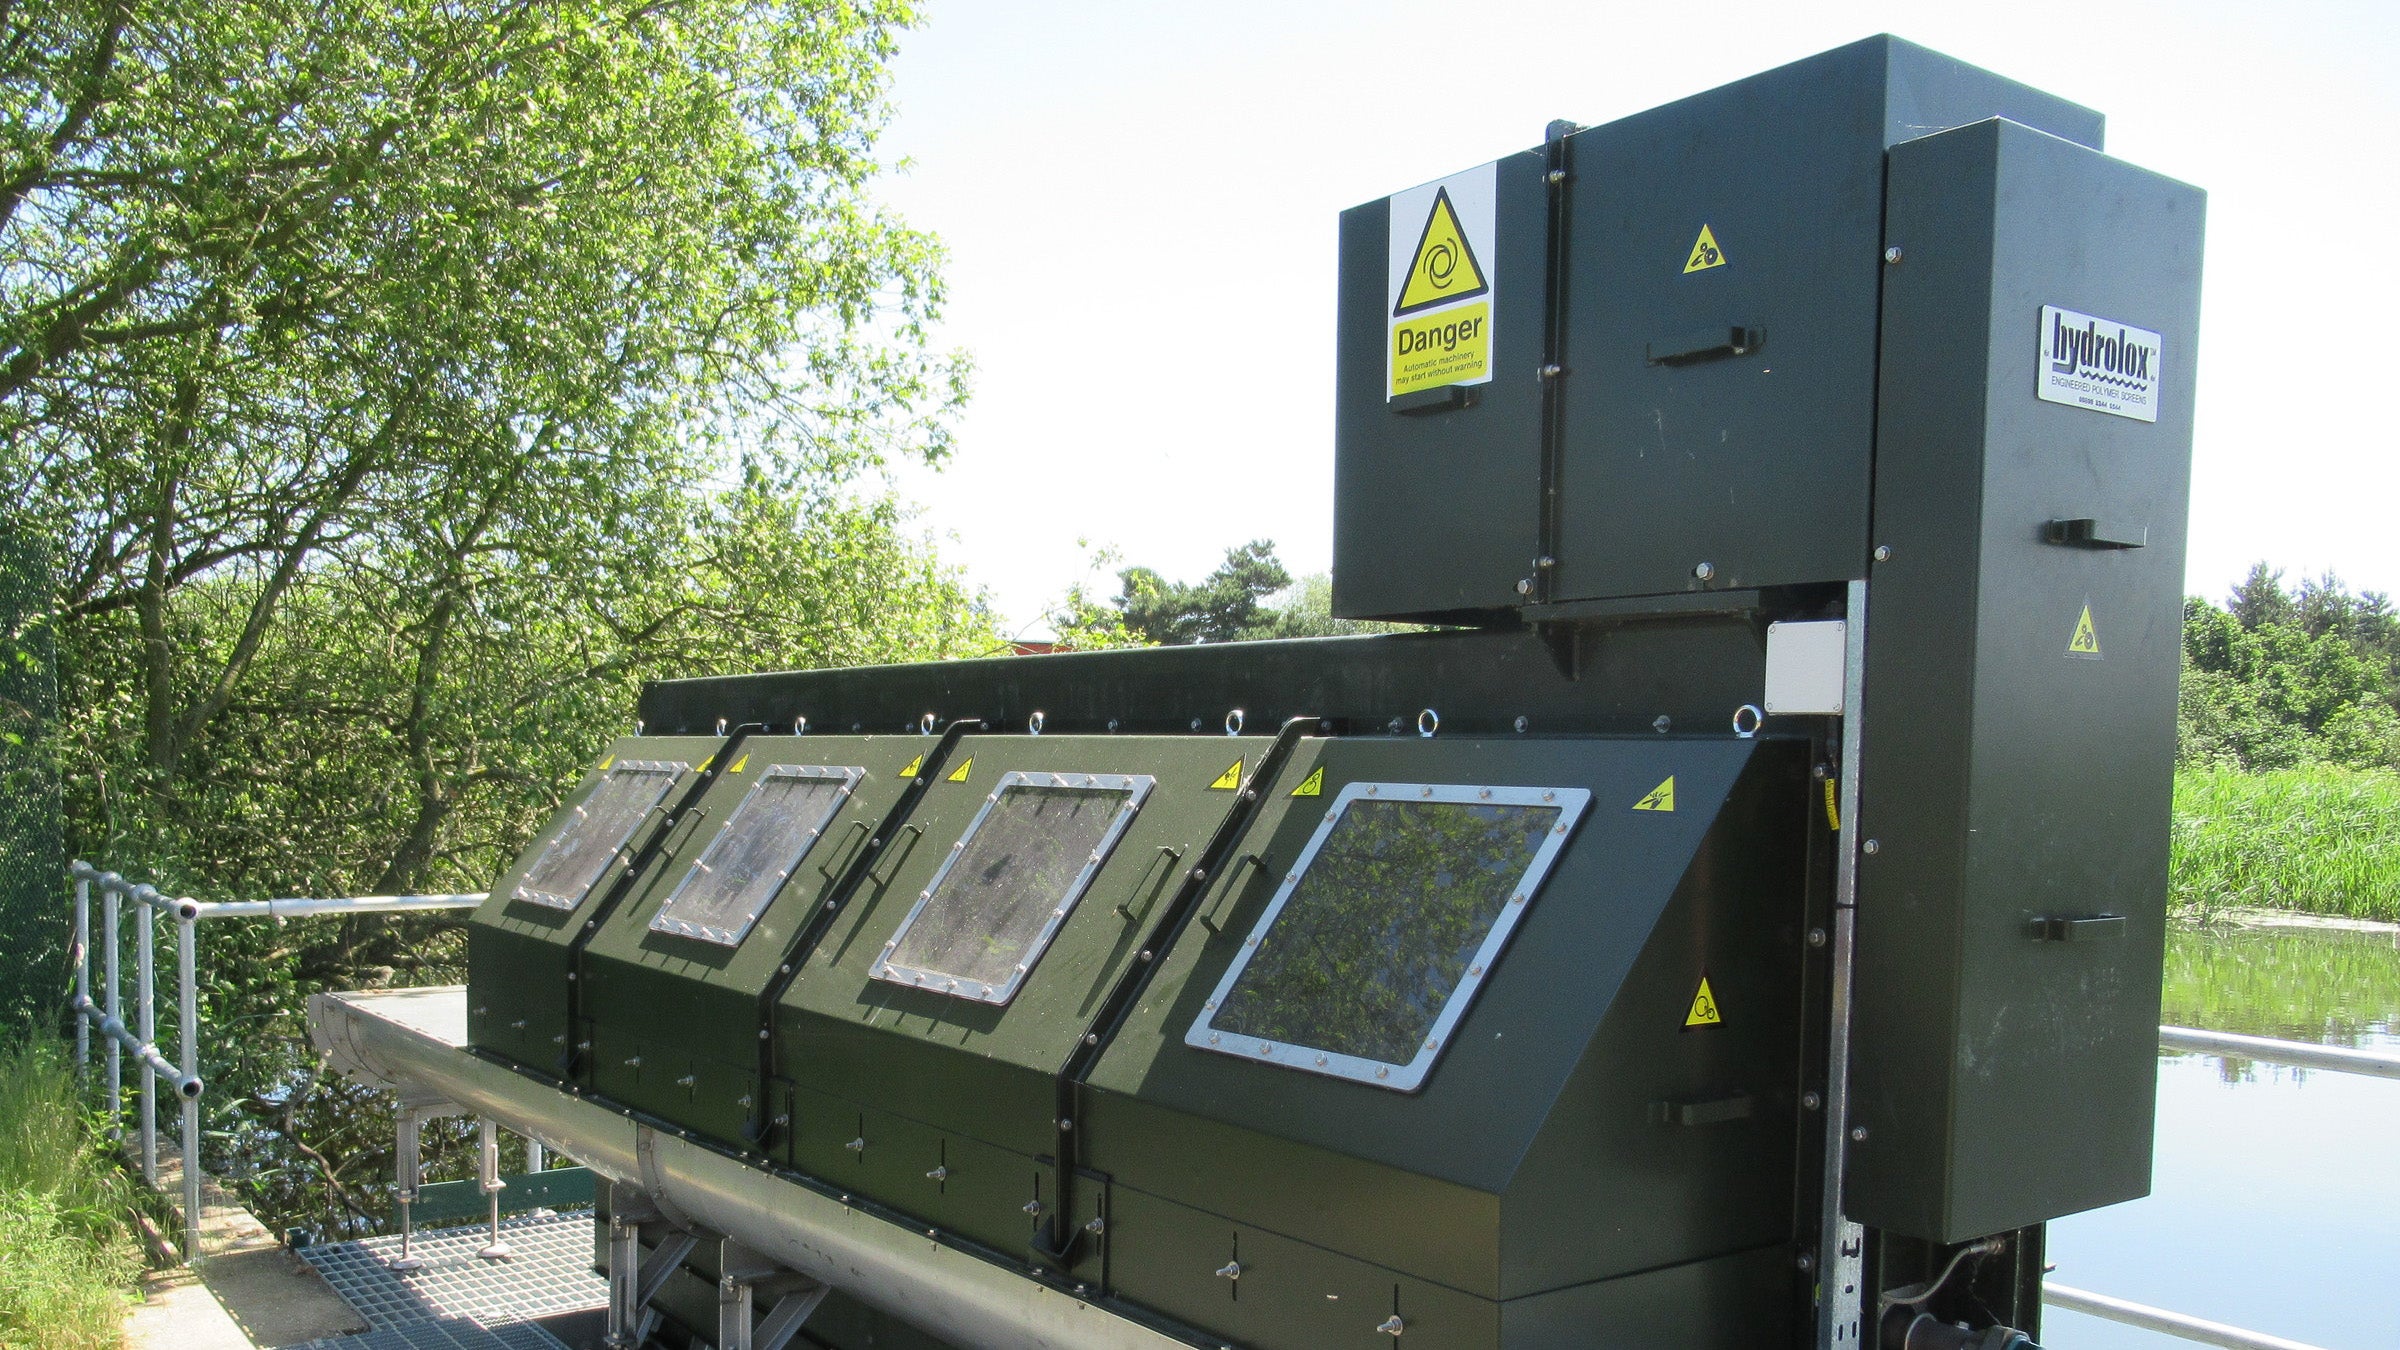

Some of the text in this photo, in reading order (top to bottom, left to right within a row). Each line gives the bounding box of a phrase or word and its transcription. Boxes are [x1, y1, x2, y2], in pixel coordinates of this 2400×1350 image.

[1398, 317, 1482, 356] Danger
[2052, 312, 2149, 380] hydrolox
[1395, 360, 1482, 385] may start without warning
[1403, 351, 1474, 373] Automatic machinery
[2051, 376, 2147, 405] ENGINEERED POLYMER SCREENS
